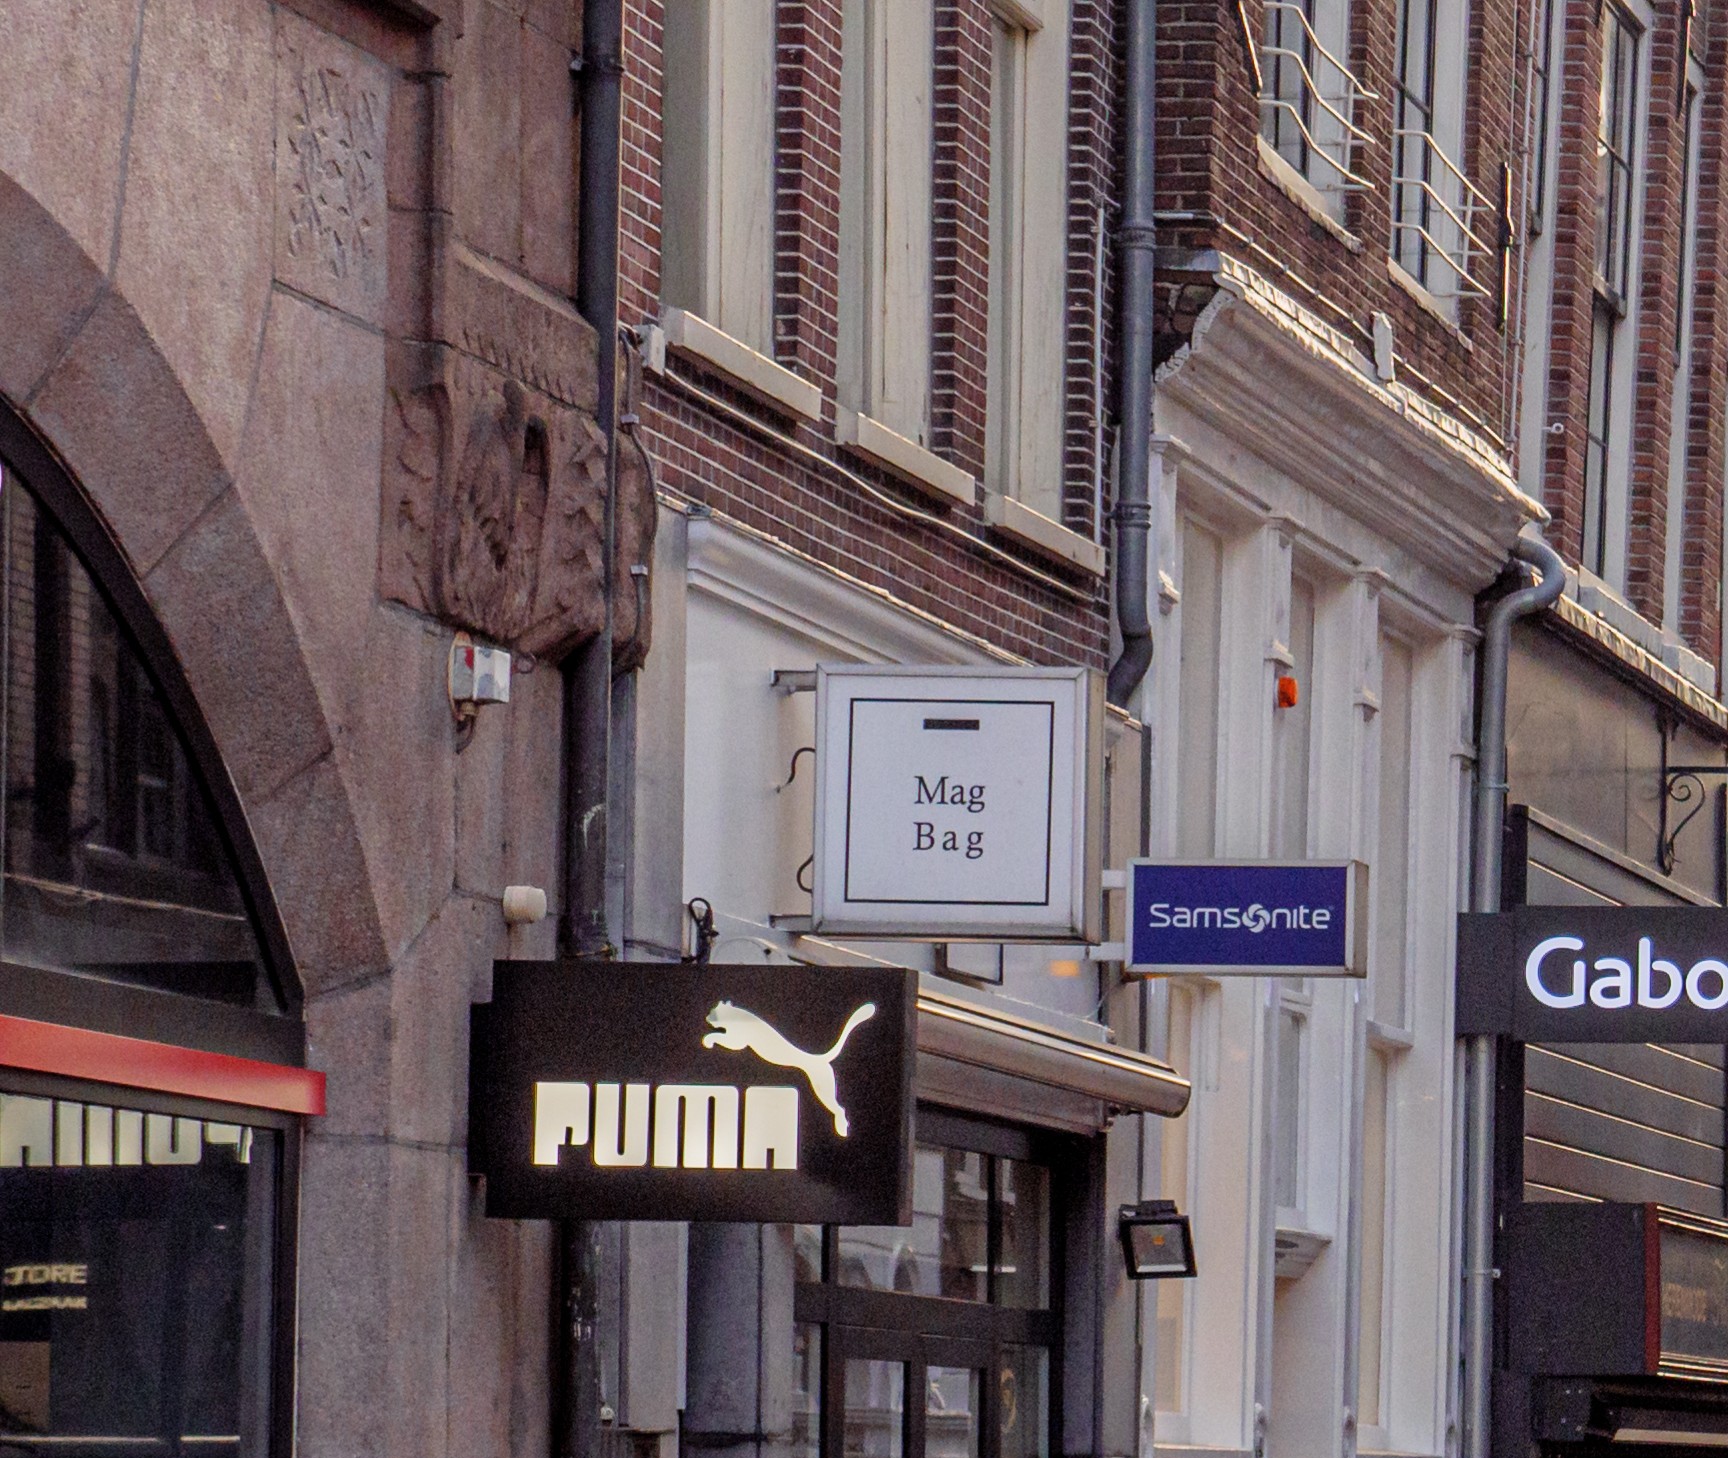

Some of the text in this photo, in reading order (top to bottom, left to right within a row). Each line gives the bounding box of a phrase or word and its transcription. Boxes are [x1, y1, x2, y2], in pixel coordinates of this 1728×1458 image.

[913, 775, 986, 814] Mag
[912, 821, 985, 860] Bag
[1149, 902, 1332, 933] Samsonite
[532, 1081, 800, 1171] PUMA
